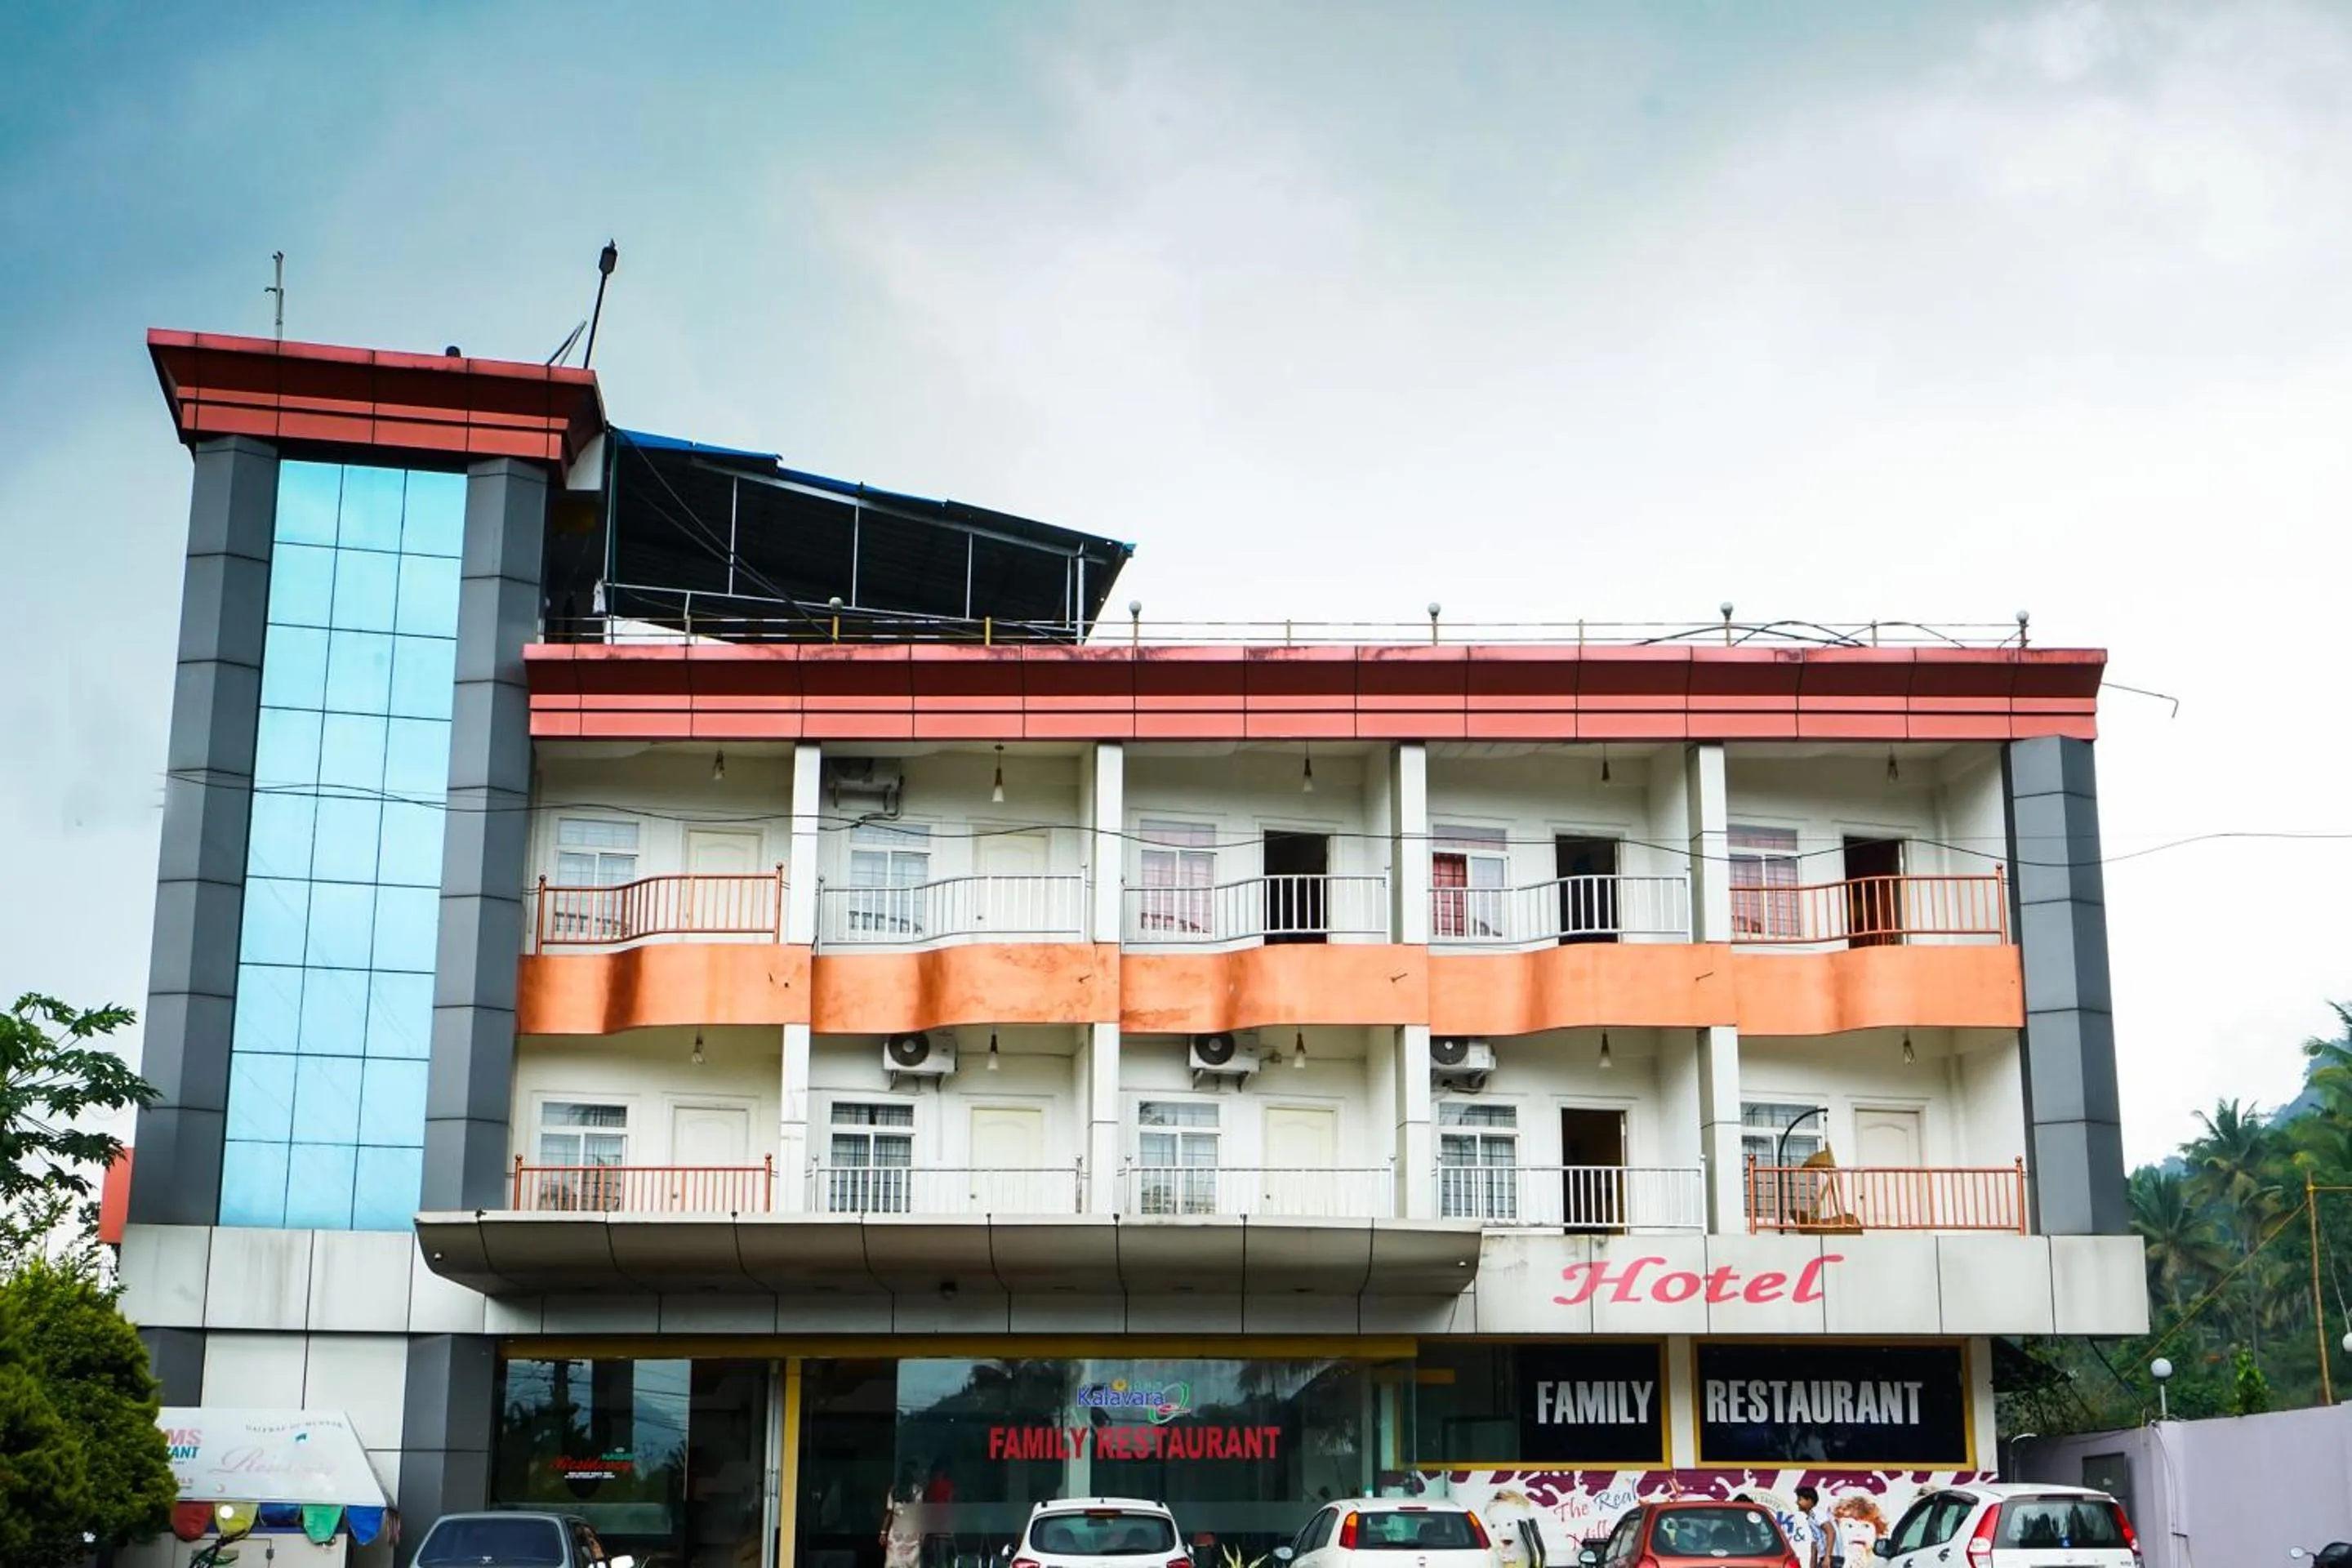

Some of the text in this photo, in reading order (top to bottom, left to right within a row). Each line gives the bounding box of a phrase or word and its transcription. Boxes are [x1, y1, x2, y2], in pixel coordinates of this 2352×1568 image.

[1553, 1254, 1844, 1305] Hotel
[1077, 1384, 1165, 1407] Kalavara
[1536, 1379, 1924, 1425] FAMILY RESTAURANT
[165, 1428, 203, 1446] MS
[988, 1426, 1281, 1459] FAMILY RESTAURANT
[1553, 1477, 1637, 1522] The Real
